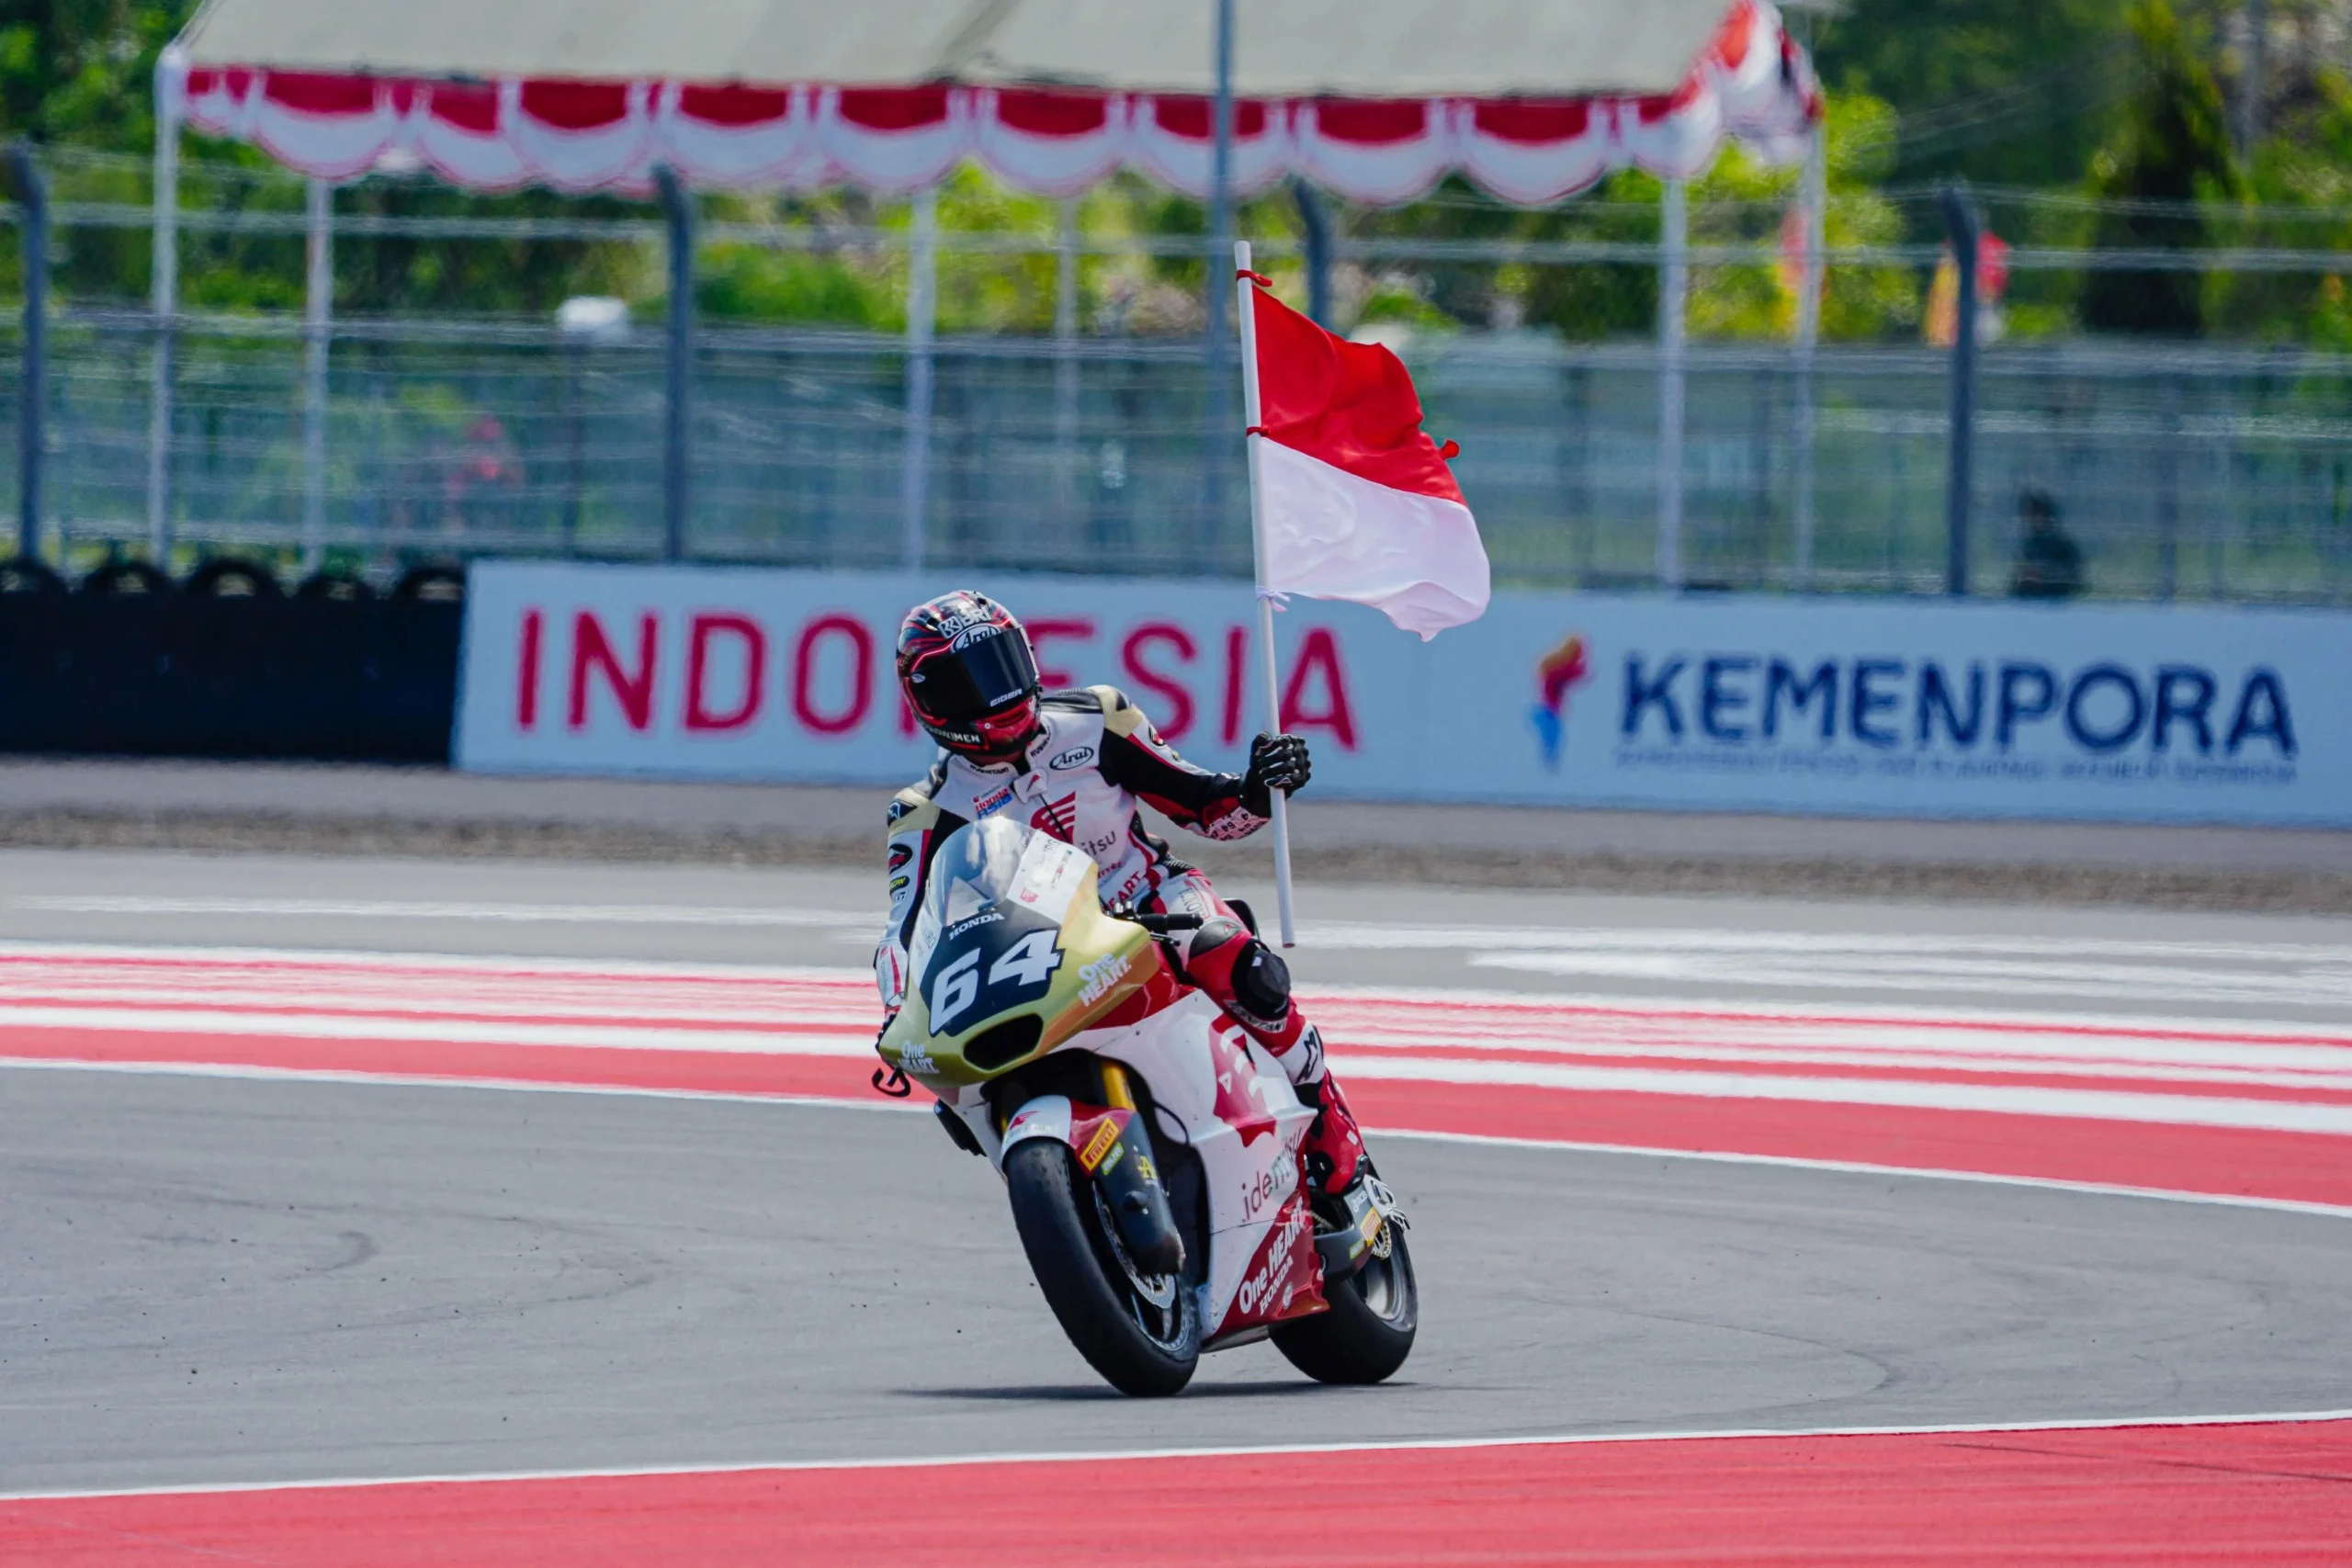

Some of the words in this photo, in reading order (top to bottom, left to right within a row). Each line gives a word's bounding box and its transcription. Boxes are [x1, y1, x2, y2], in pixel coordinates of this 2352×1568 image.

[517, 608, 1357, 750] INDOESIA
[989, 689, 1023, 707] EIGER
[1621, 656, 2297, 759] KEMENPORA
[1055, 747, 1091, 769] Arai
[1107, 870, 1142, 908] EART
[949, 912, 1005, 941] HONDA
[930, 930, 1063, 1035] 64
[1079, 953, 1115, 982] One
[901, 1040, 926, 1059] One
[1240, 1266, 1267, 1314] One
[1260, 1255, 1294, 1316] HONDA
